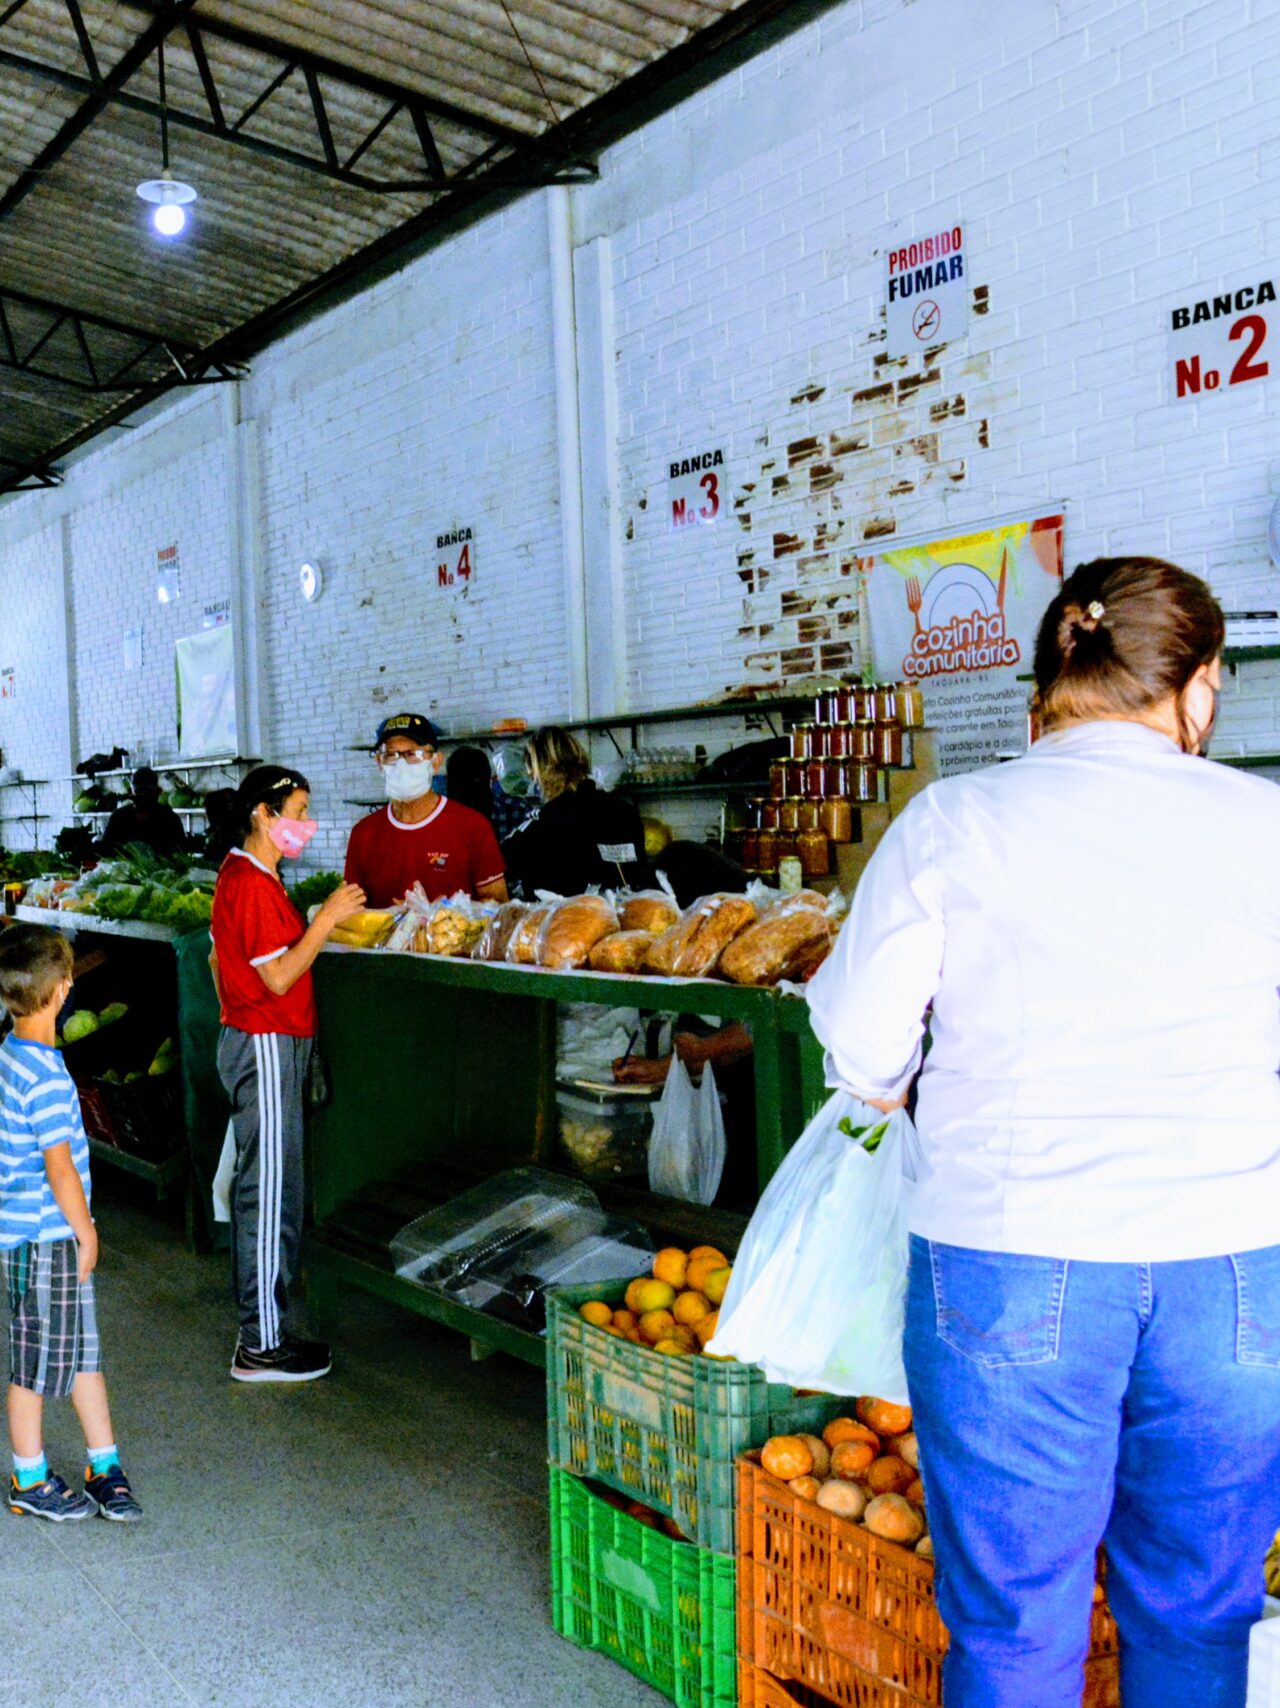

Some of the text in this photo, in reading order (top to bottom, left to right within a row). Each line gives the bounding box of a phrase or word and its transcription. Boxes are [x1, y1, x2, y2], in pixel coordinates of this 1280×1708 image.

[889, 226, 962, 276] PROIBIDO
[889, 254, 963, 302] FUMAR
[1172, 281, 1276, 331] BANCA
[1228, 315, 1269, 385] 2
[670, 449, 723, 479] BANCA
[700, 472, 720, 519] 3
[437, 527, 472, 549] BANCA
[457, 543, 472, 581] 4
[913, 613, 1004, 656] cozinha
[904, 639, 1020, 676] comunitária
[946, 722, 978, 733] carente
[981, 722, 995, 732] em
[965, 706, 1003, 720] gratuitas
[944, 740, 983, 752] cardápio
[985, 740, 991, 749] e
[945, 754, 979, 767] próxima
